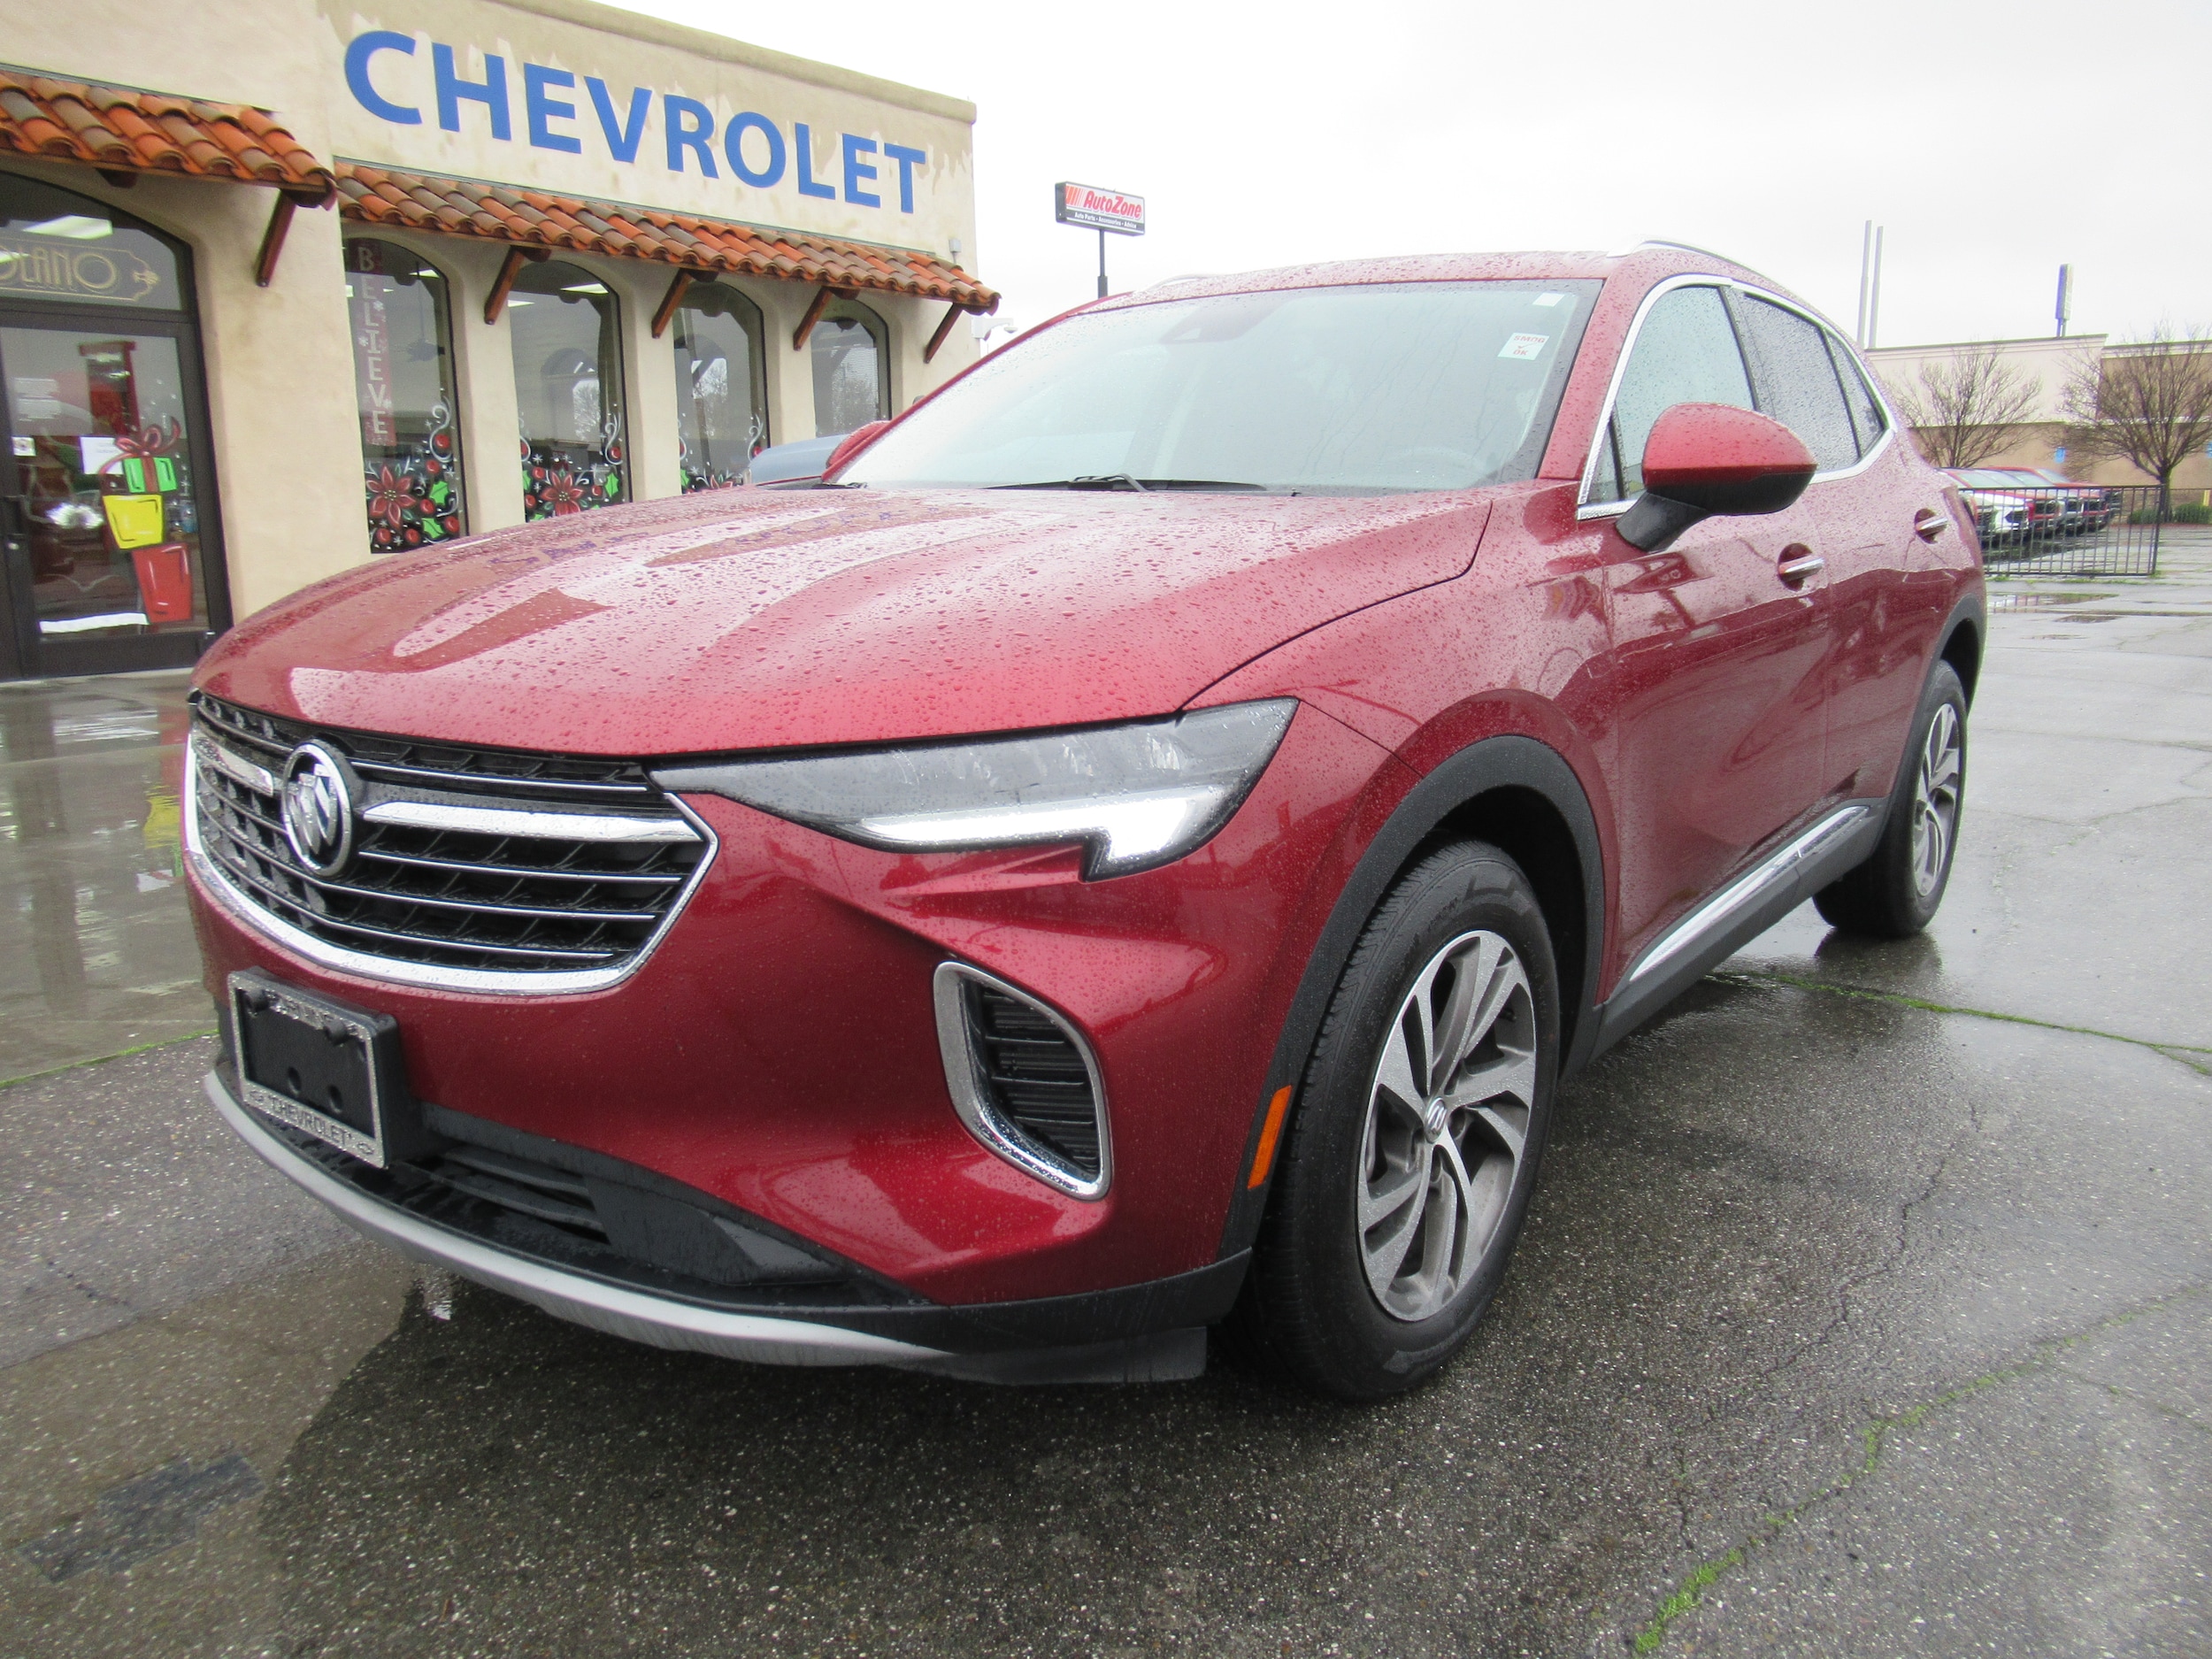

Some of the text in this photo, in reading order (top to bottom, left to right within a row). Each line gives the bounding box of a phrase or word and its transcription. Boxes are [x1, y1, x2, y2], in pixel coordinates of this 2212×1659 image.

[344, 30, 926, 214] CHEVROLET
[1084, 190, 1141, 218] AutoZone
[357, 246, 388, 434] BELIEVE
